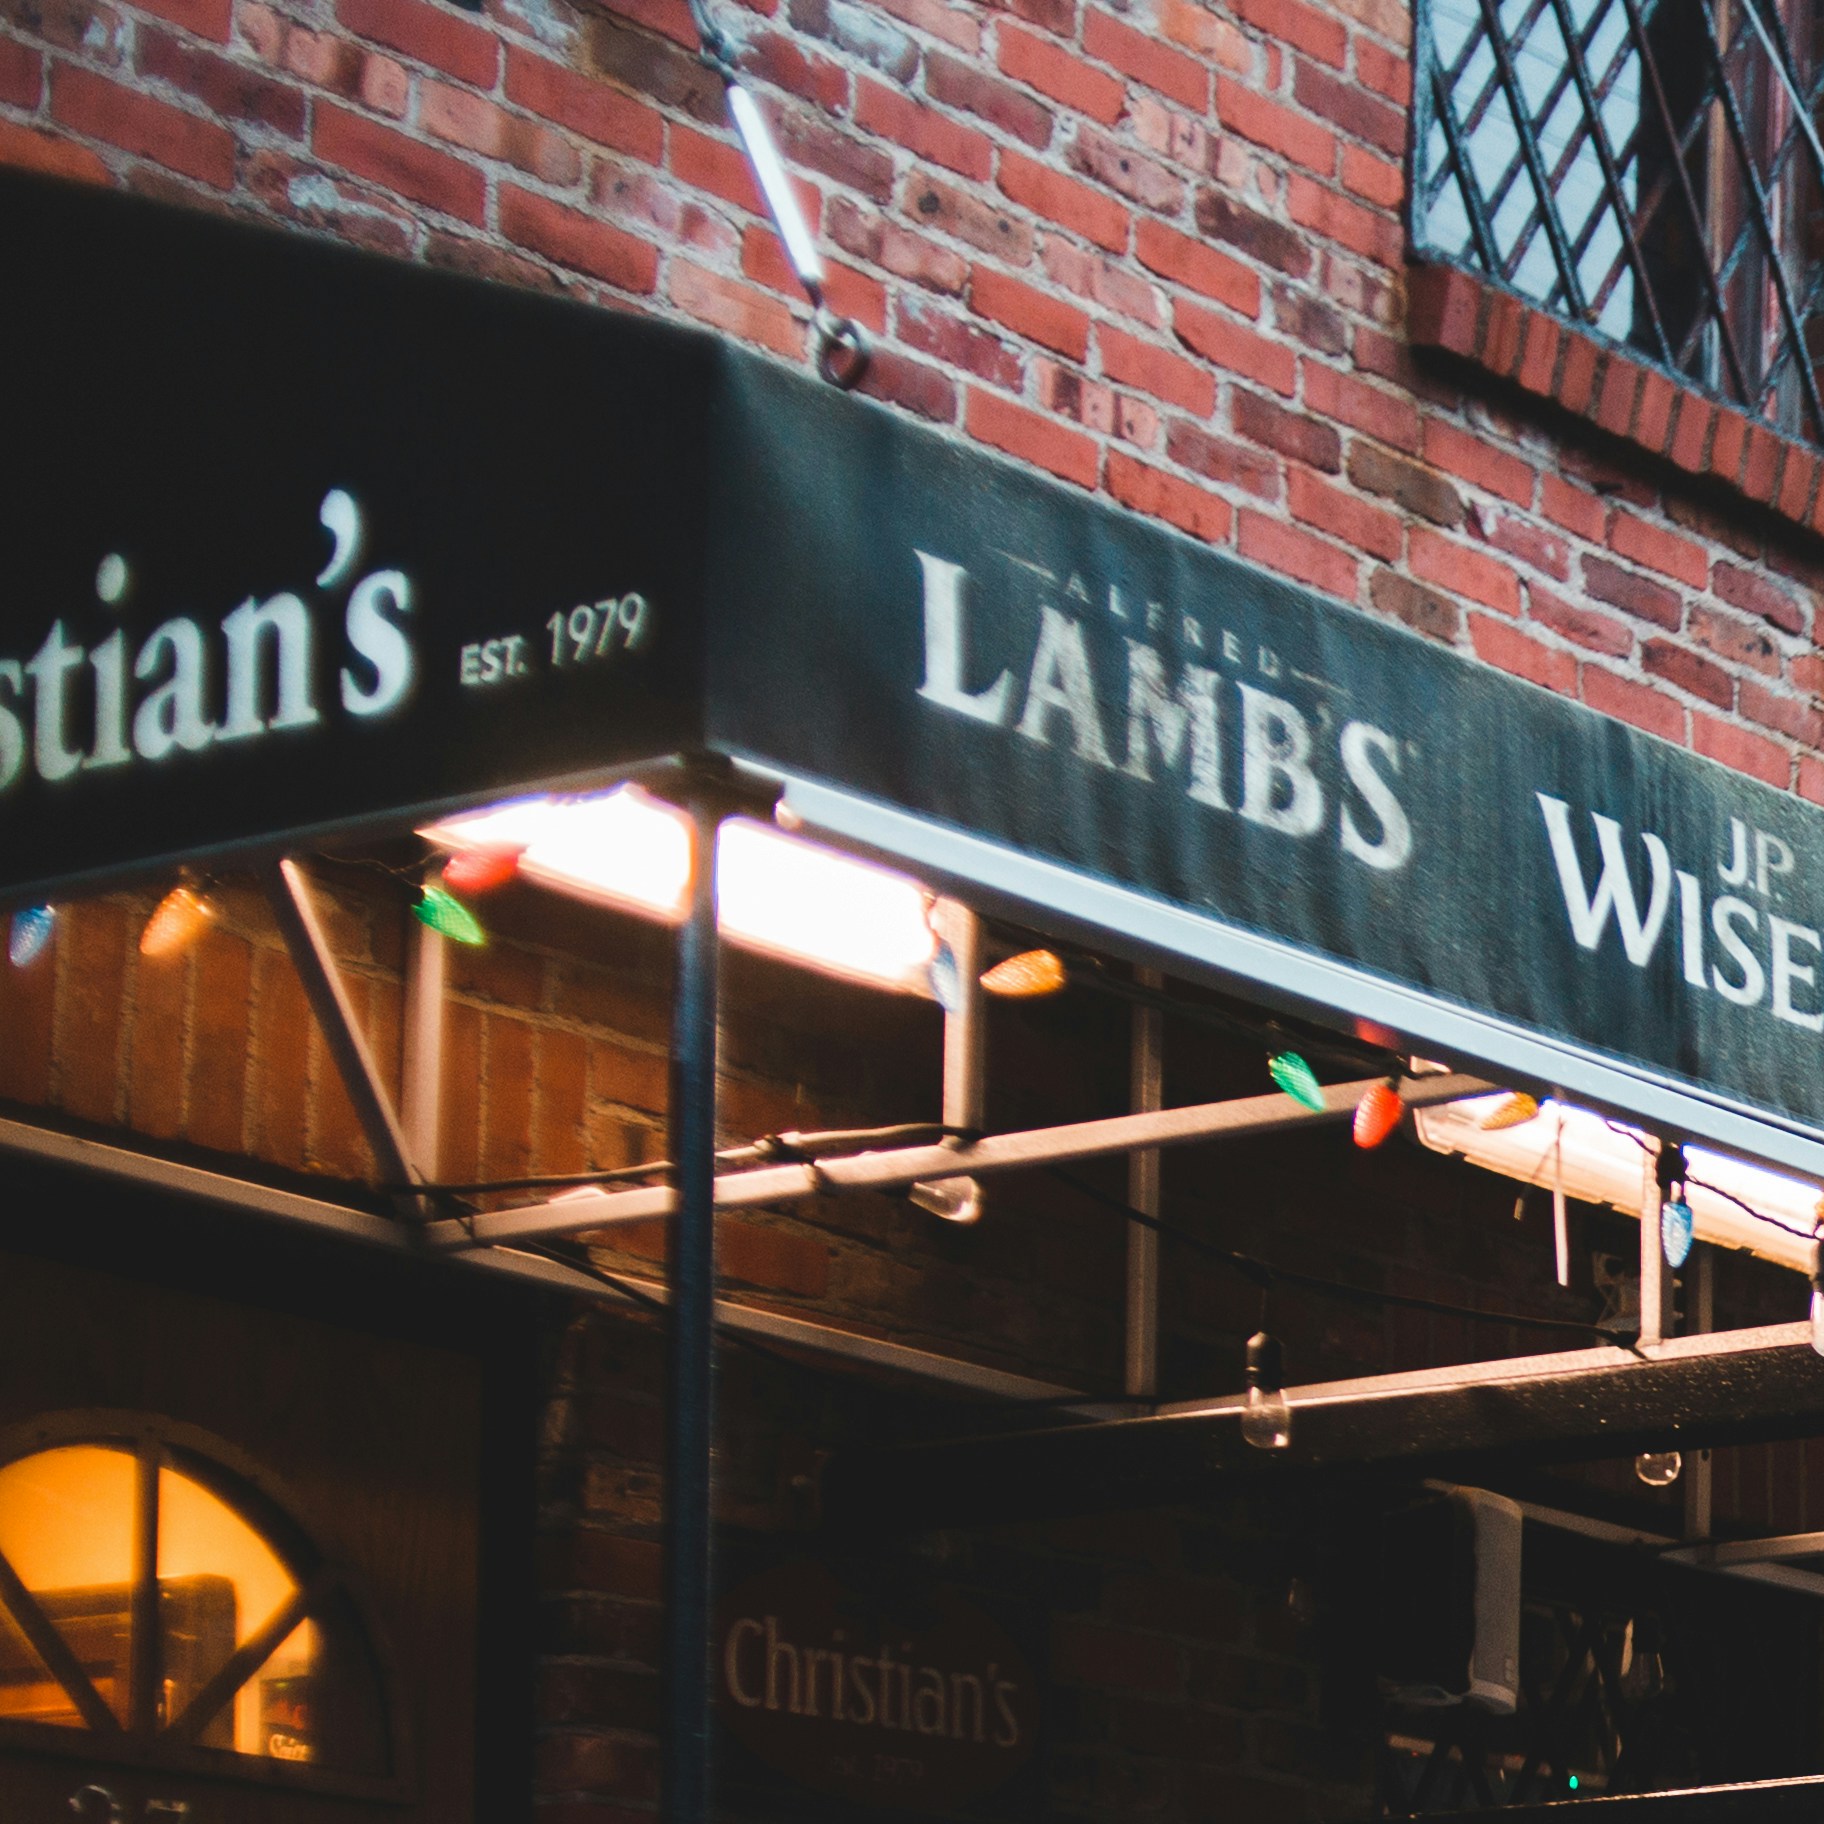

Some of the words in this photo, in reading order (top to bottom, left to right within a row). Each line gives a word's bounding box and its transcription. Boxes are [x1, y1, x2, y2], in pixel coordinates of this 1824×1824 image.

[460, 634, 528, 686] EST.
[546, 591, 648, 667] 1979
[1064, 571, 1281, 679] ALFRED
[724, 1615, 1020, 1748] Christian's
